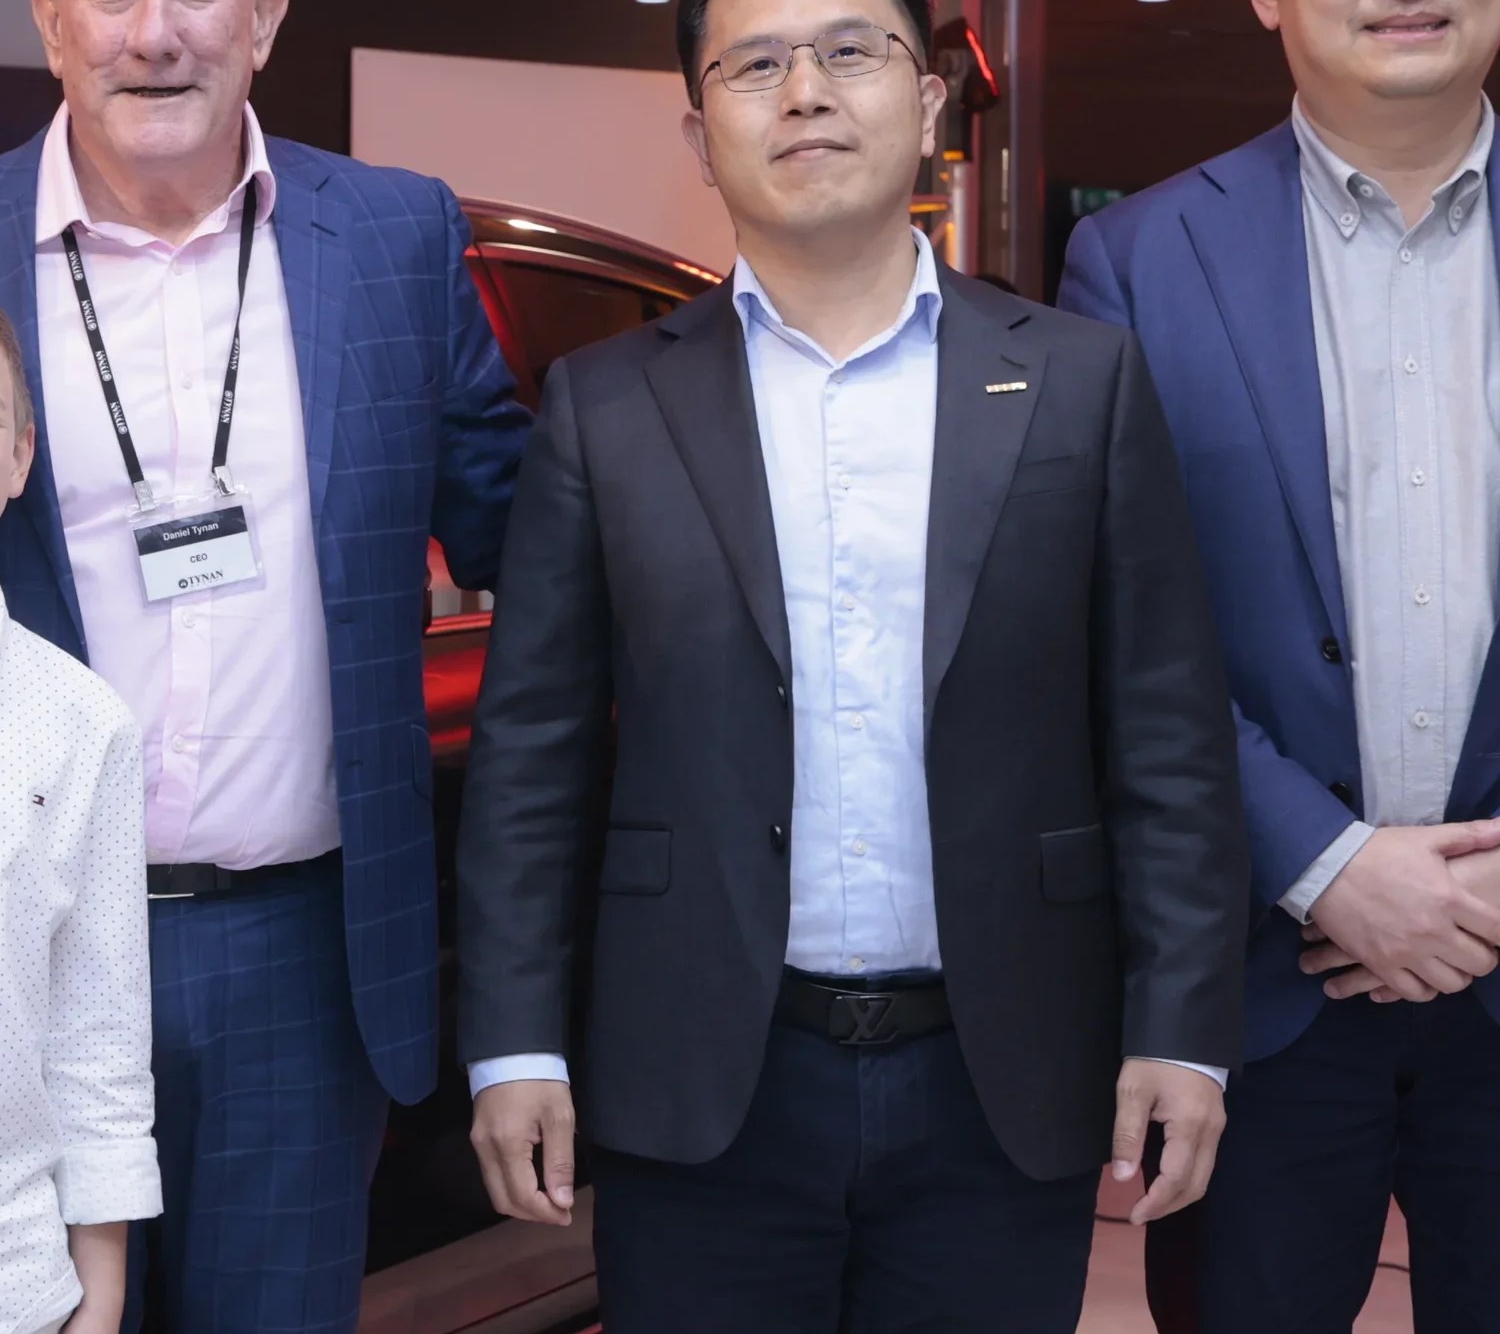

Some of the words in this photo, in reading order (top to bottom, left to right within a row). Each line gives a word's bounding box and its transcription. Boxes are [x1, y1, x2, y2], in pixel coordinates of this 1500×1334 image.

[162, 528, 190, 541] Daniel
[191, 522, 219, 535] Tynan
[190, 553, 208, 563] CEO
[188, 569, 224, 584] TYNAN
